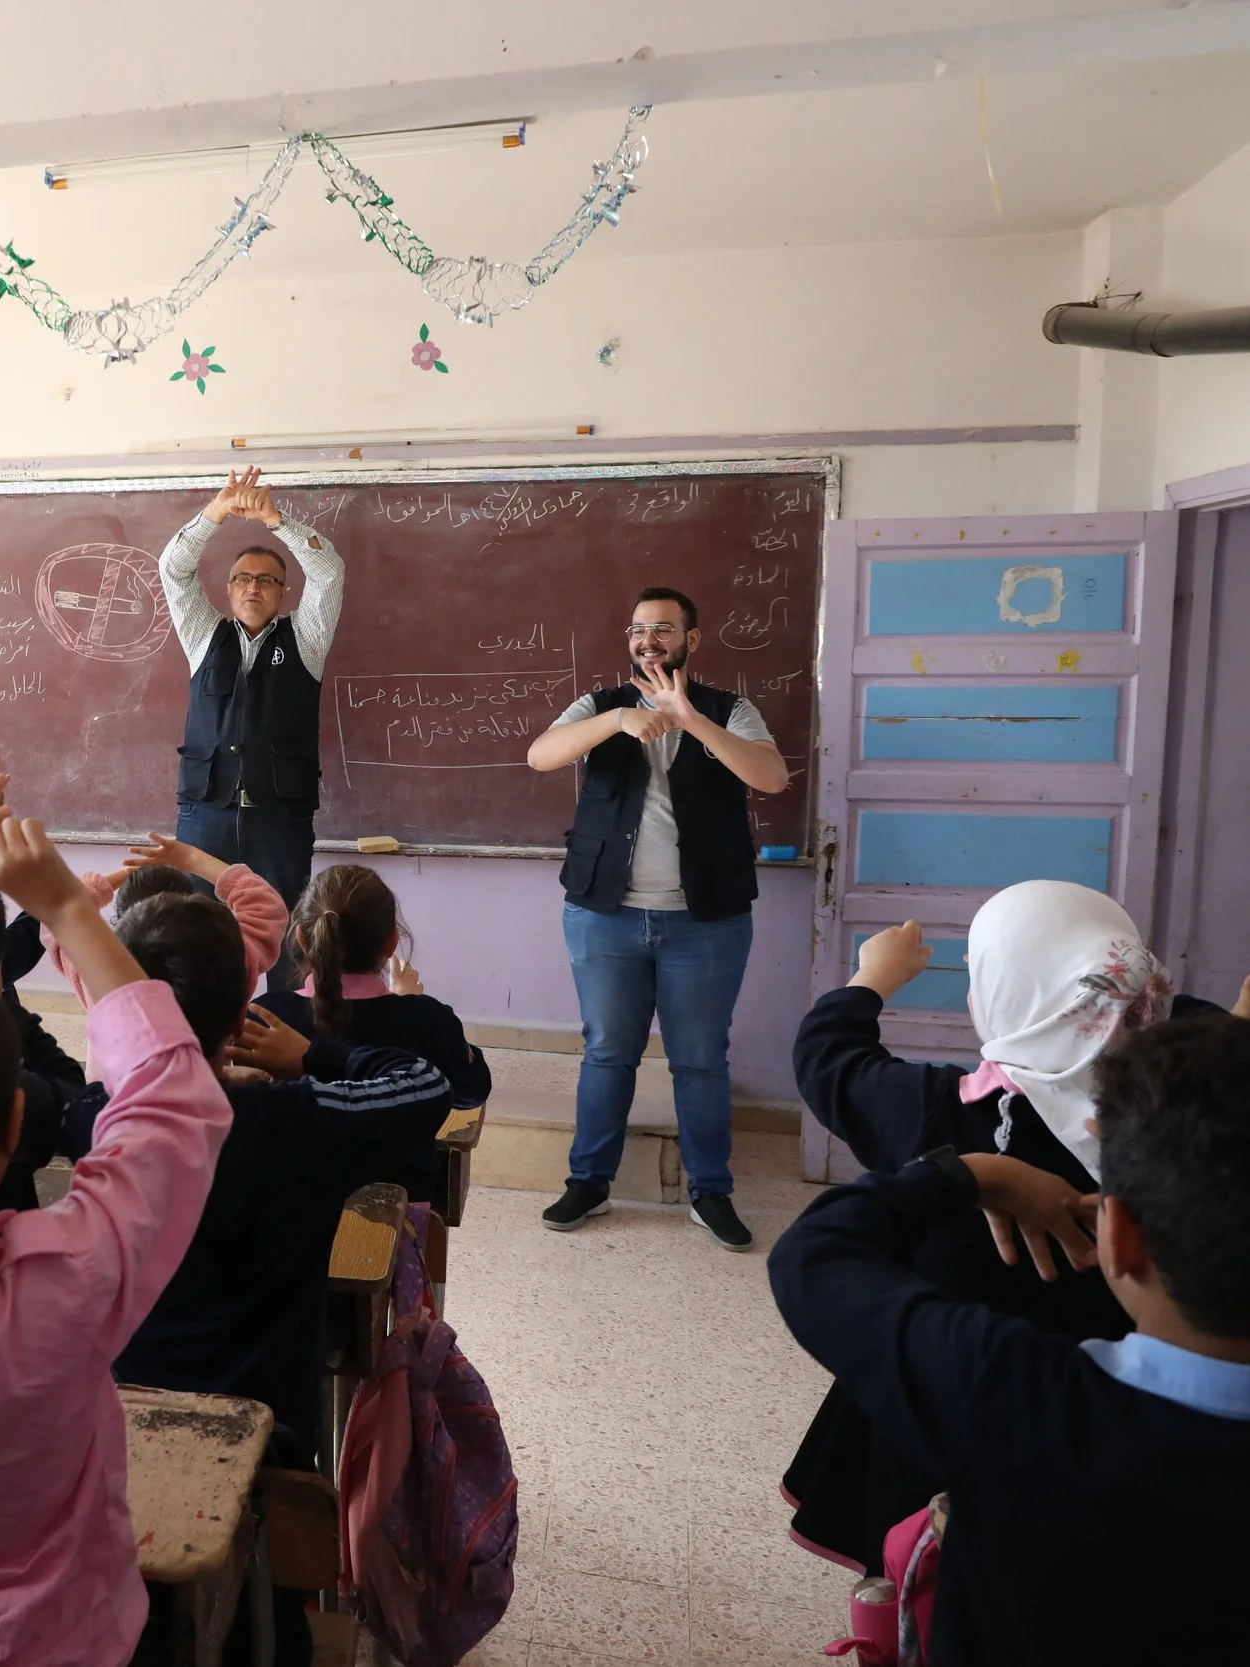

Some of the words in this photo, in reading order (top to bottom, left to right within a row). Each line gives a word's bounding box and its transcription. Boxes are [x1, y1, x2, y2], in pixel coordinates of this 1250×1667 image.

[733, 564, 789, 589] المادة
[477, 622, 545, 657] الجدري
[9, 671, 47, 703] بالحامل
[386, 715, 422, 761] الدم
[458, 726, 473, 744] من
[478, 715, 529, 743] للوقاية
